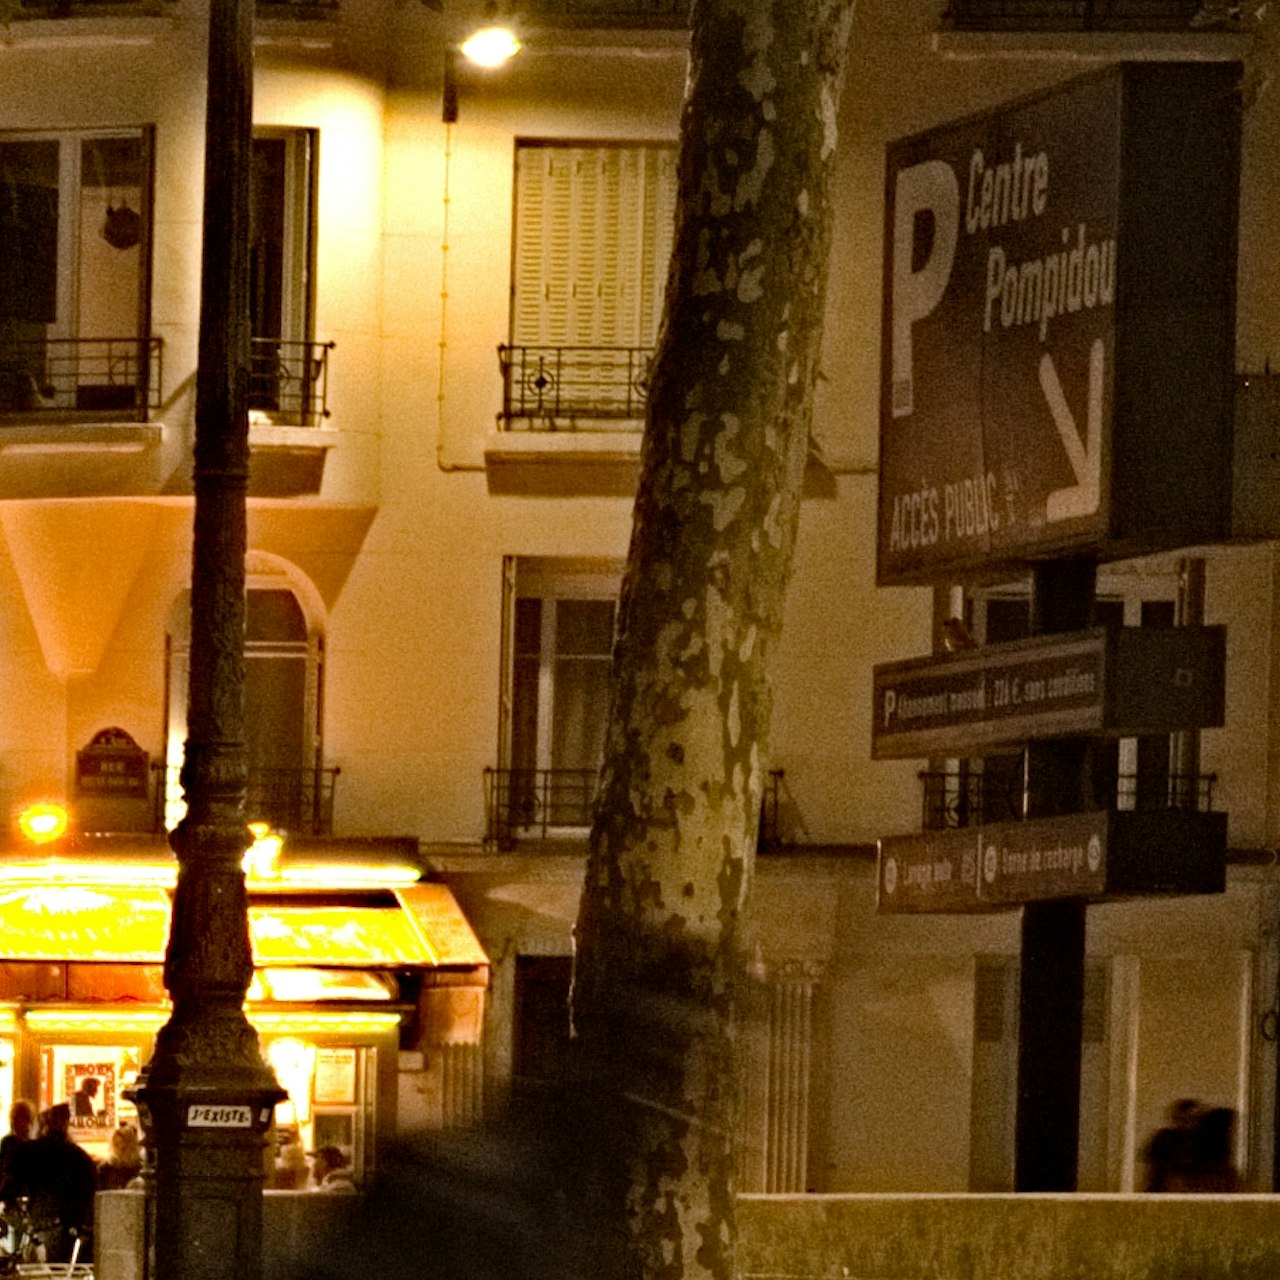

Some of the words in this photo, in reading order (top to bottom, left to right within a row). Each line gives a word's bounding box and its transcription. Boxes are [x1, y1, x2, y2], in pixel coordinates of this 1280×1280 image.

[965, 142, 1049, 235] Centre
[892, 159, 960, 419] P
[983, 223, 1117, 343] Pompidou
[889, 476, 939, 552] ACCÈS
[944, 471, 1000, 542] PUBLIC
